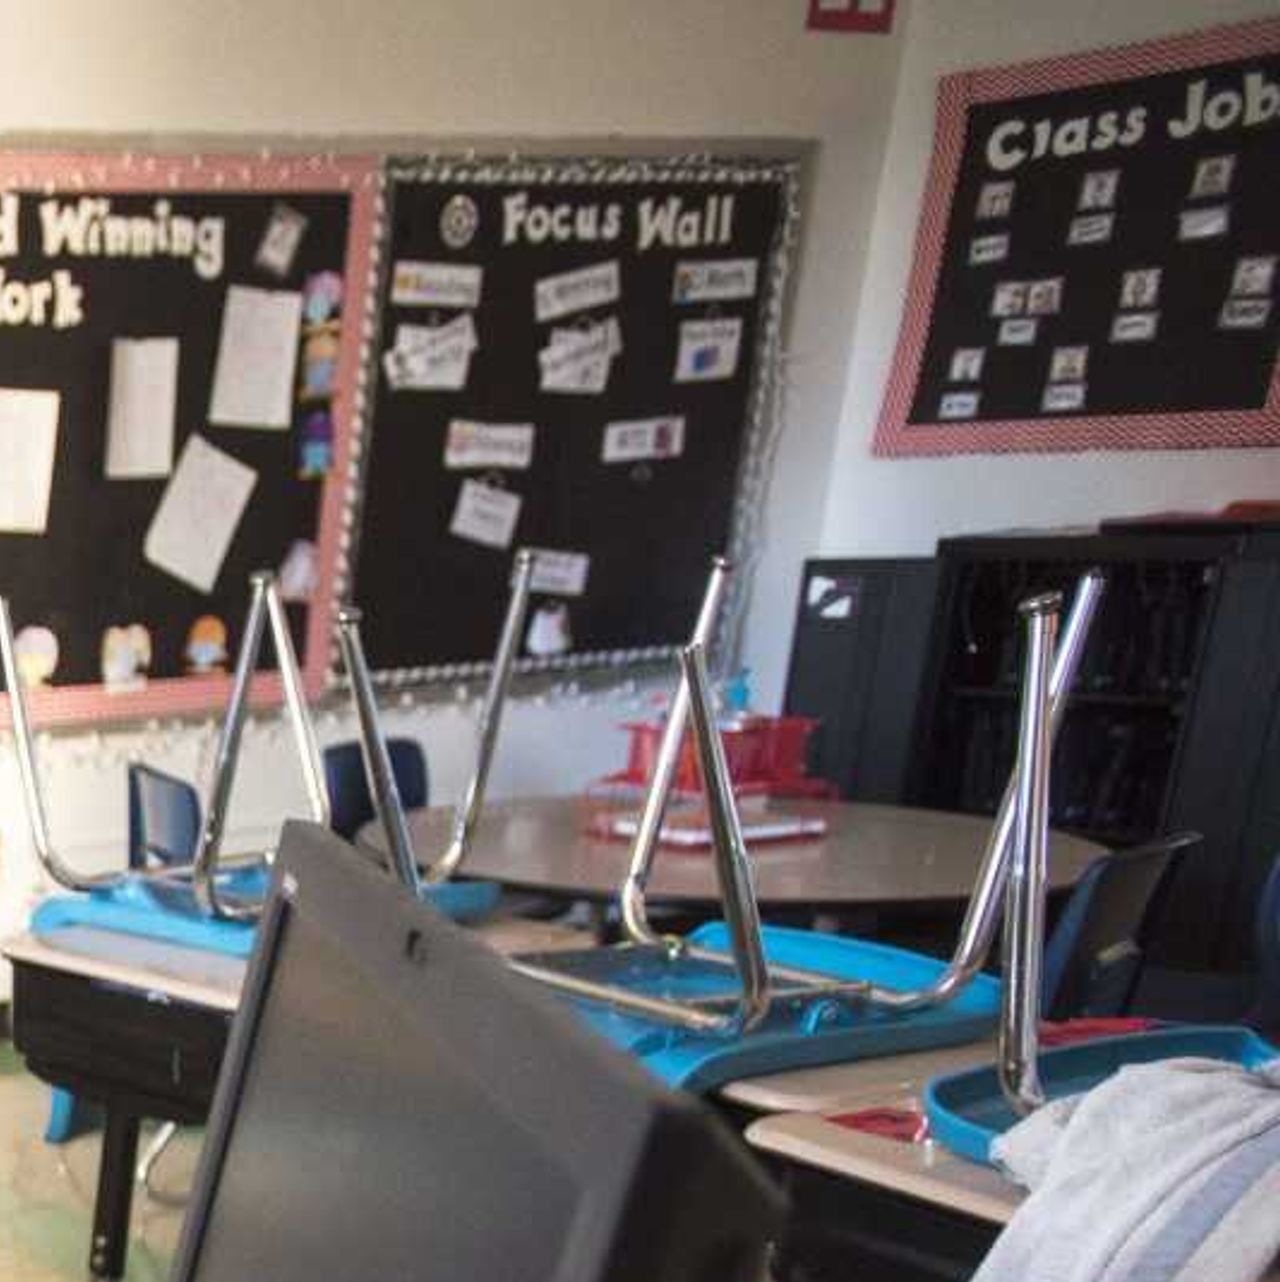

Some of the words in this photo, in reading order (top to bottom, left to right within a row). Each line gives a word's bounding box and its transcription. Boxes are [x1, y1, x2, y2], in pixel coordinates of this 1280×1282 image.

[986, 107, 1146, 171] Class
[1167, 72, 1280, 138] Job
[40, 197, 226, 280] Winning
[502, 191, 621, 246] Focus
[638, 196, 734, 250] Wall
